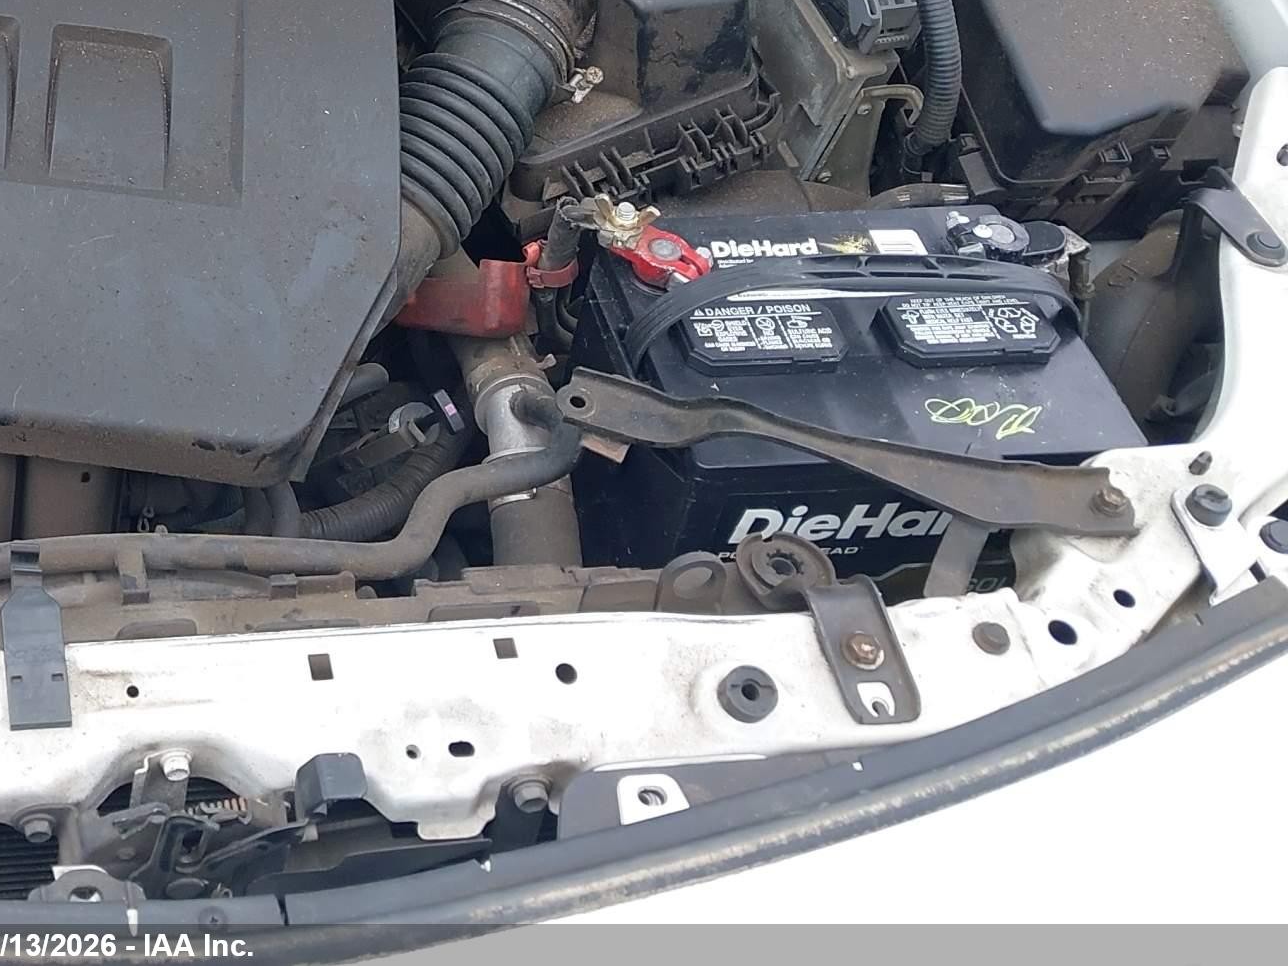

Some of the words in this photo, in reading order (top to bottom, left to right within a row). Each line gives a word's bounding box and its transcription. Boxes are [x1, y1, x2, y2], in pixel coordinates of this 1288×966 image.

[710, 237, 820, 258] DieHard
[704, 305, 754, 316] DANGER
[757, 305, 763, 315] /
[766, 304, 811, 313] POISON
[727, 502, 953, 544] DieHar
